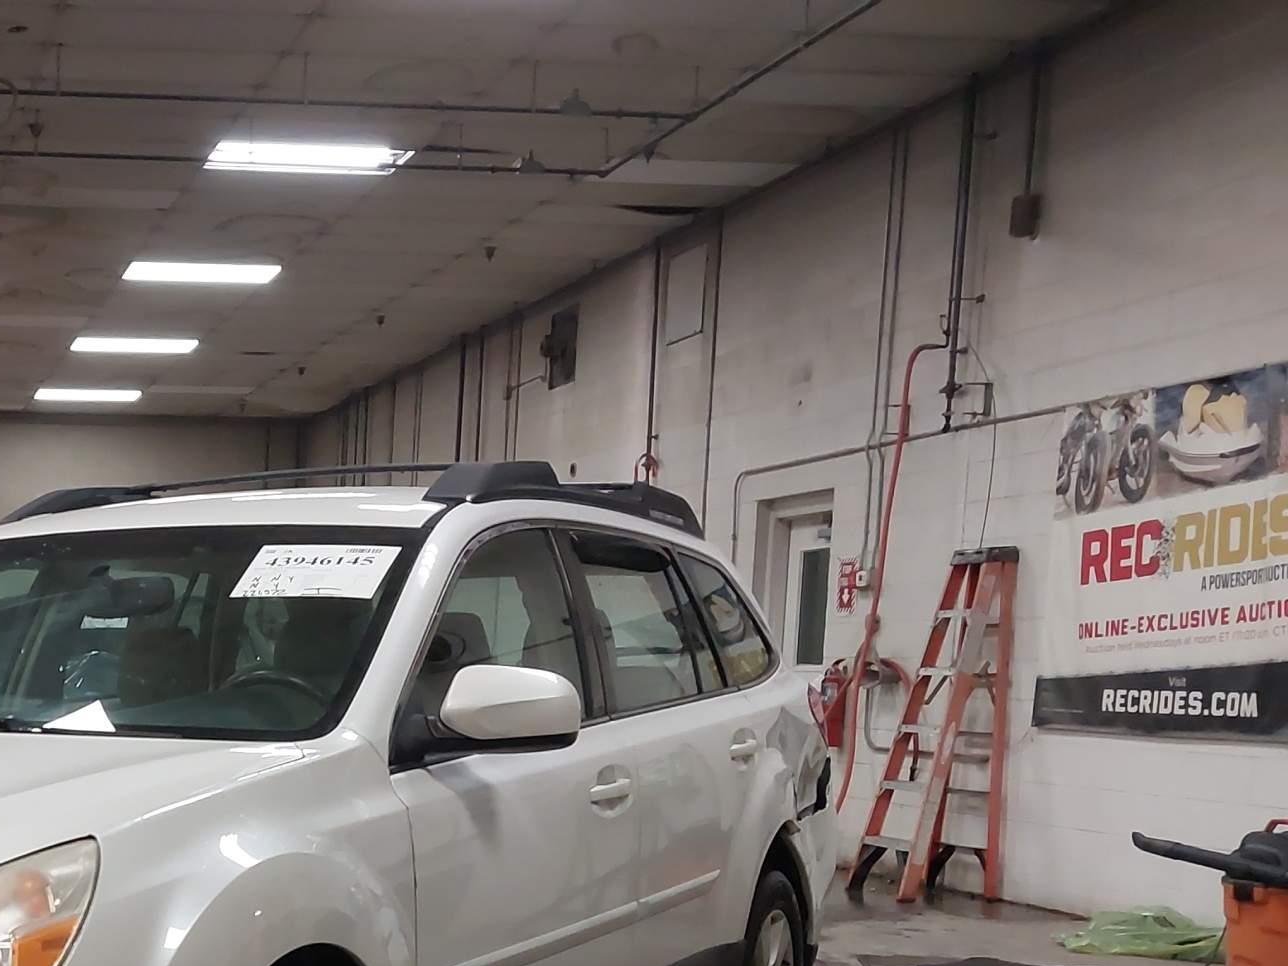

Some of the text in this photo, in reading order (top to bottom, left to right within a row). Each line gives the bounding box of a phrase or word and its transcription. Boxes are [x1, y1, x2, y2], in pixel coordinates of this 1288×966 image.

[1080, 493, 1288, 586] REC RIDES
[264, 556, 376, 567] 43946145
[1201, 576, 1207, 592] A
[1078, 606, 1231, 640] ONLINE-EXCLUSIVE
[1101, 689, 1258, 718] RECRIDES.COM
